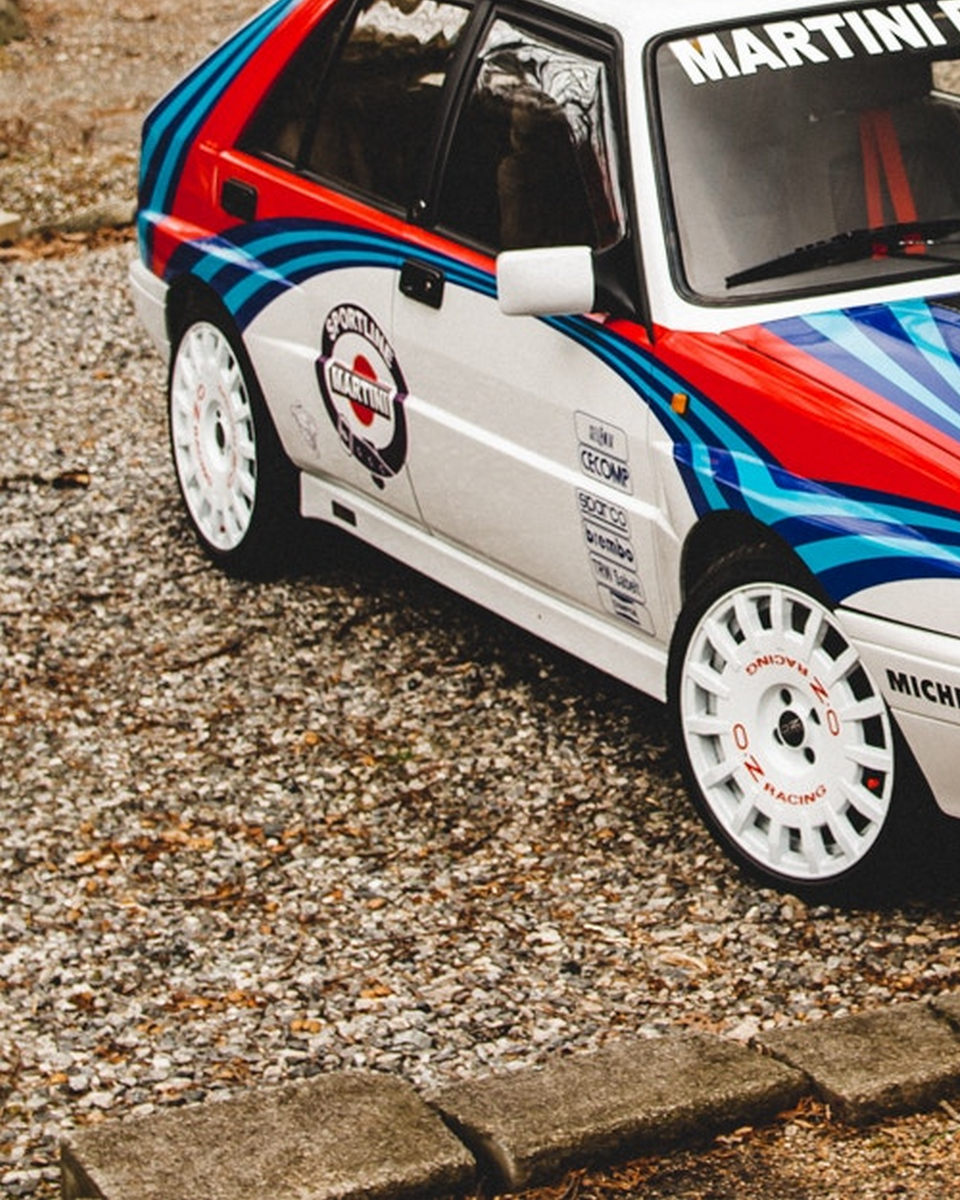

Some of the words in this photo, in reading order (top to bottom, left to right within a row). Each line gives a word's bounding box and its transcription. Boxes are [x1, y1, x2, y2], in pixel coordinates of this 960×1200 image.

[667, 4, 948, 85] MARTINI
[331, 366, 391, 417] MARTINI
[580, 450, 630, 488] CECOMP
[745, 653, 809, 678] RACING
[763, 782, 828, 806] RACING
